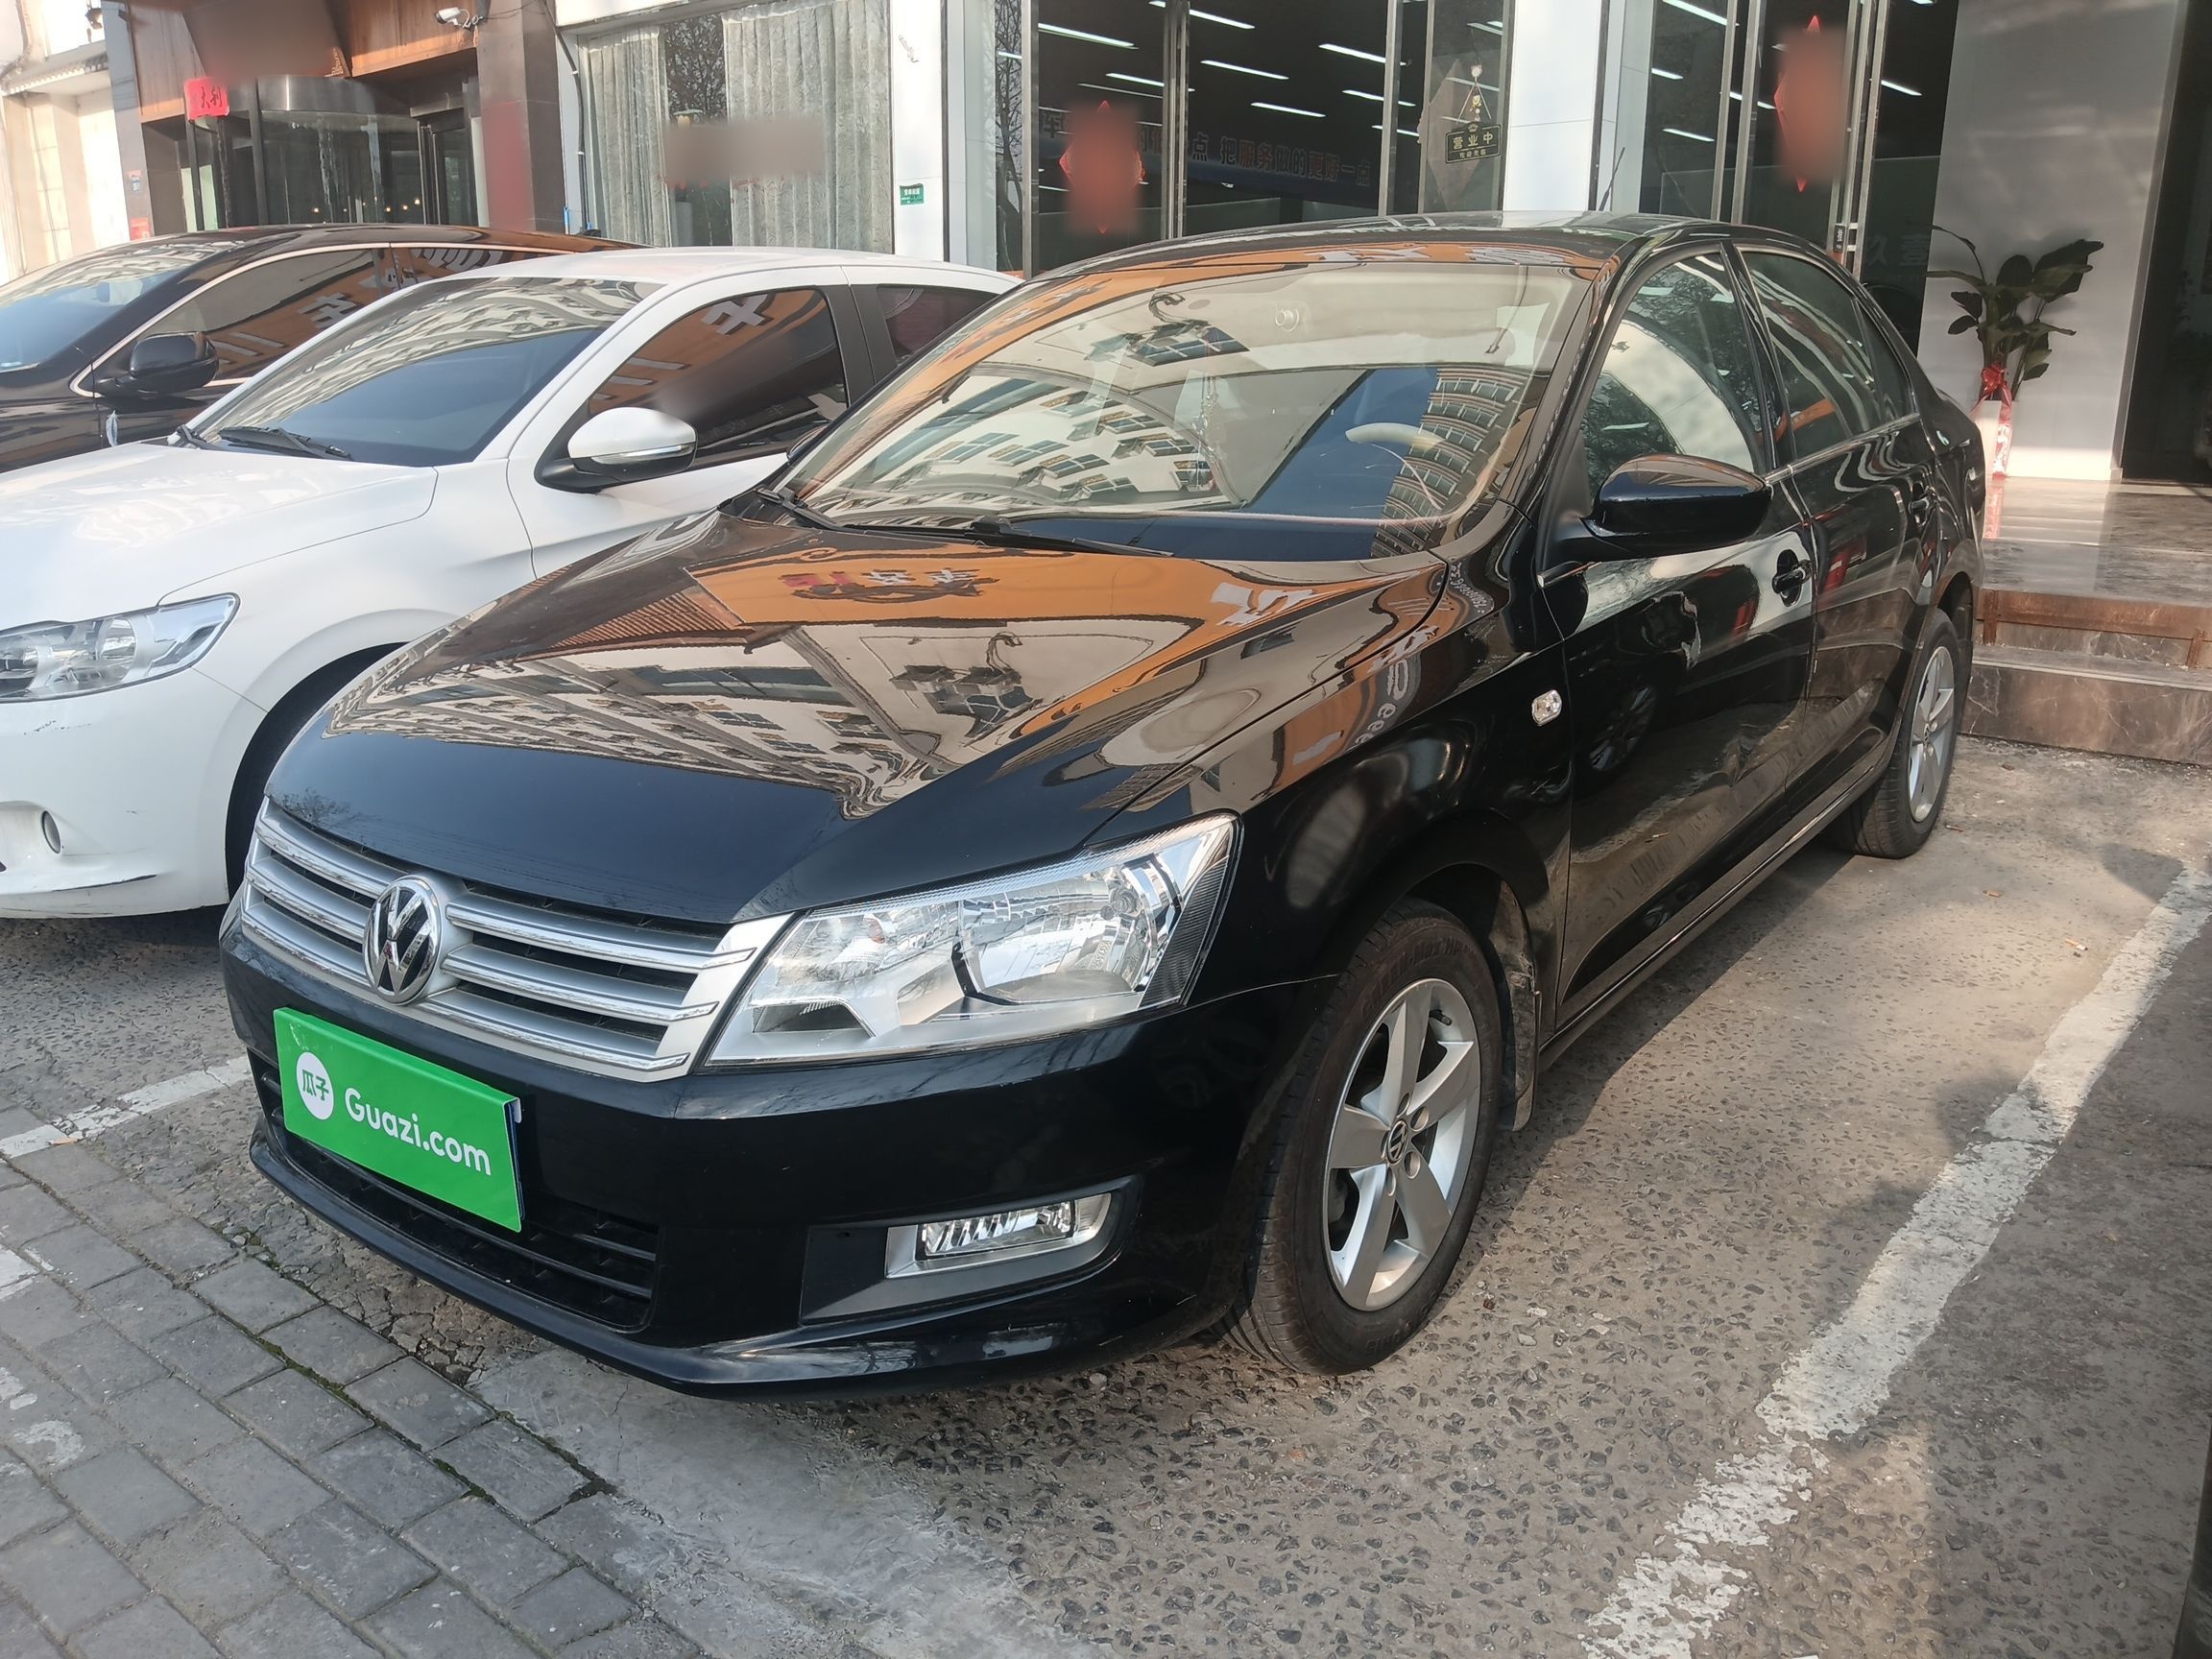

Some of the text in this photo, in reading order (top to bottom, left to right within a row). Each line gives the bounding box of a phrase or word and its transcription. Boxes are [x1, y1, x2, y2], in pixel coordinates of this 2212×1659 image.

[1453, 131, 1494, 150] 营业中
[301, 1069, 492, 1176] 瓜子 Guazi.com
